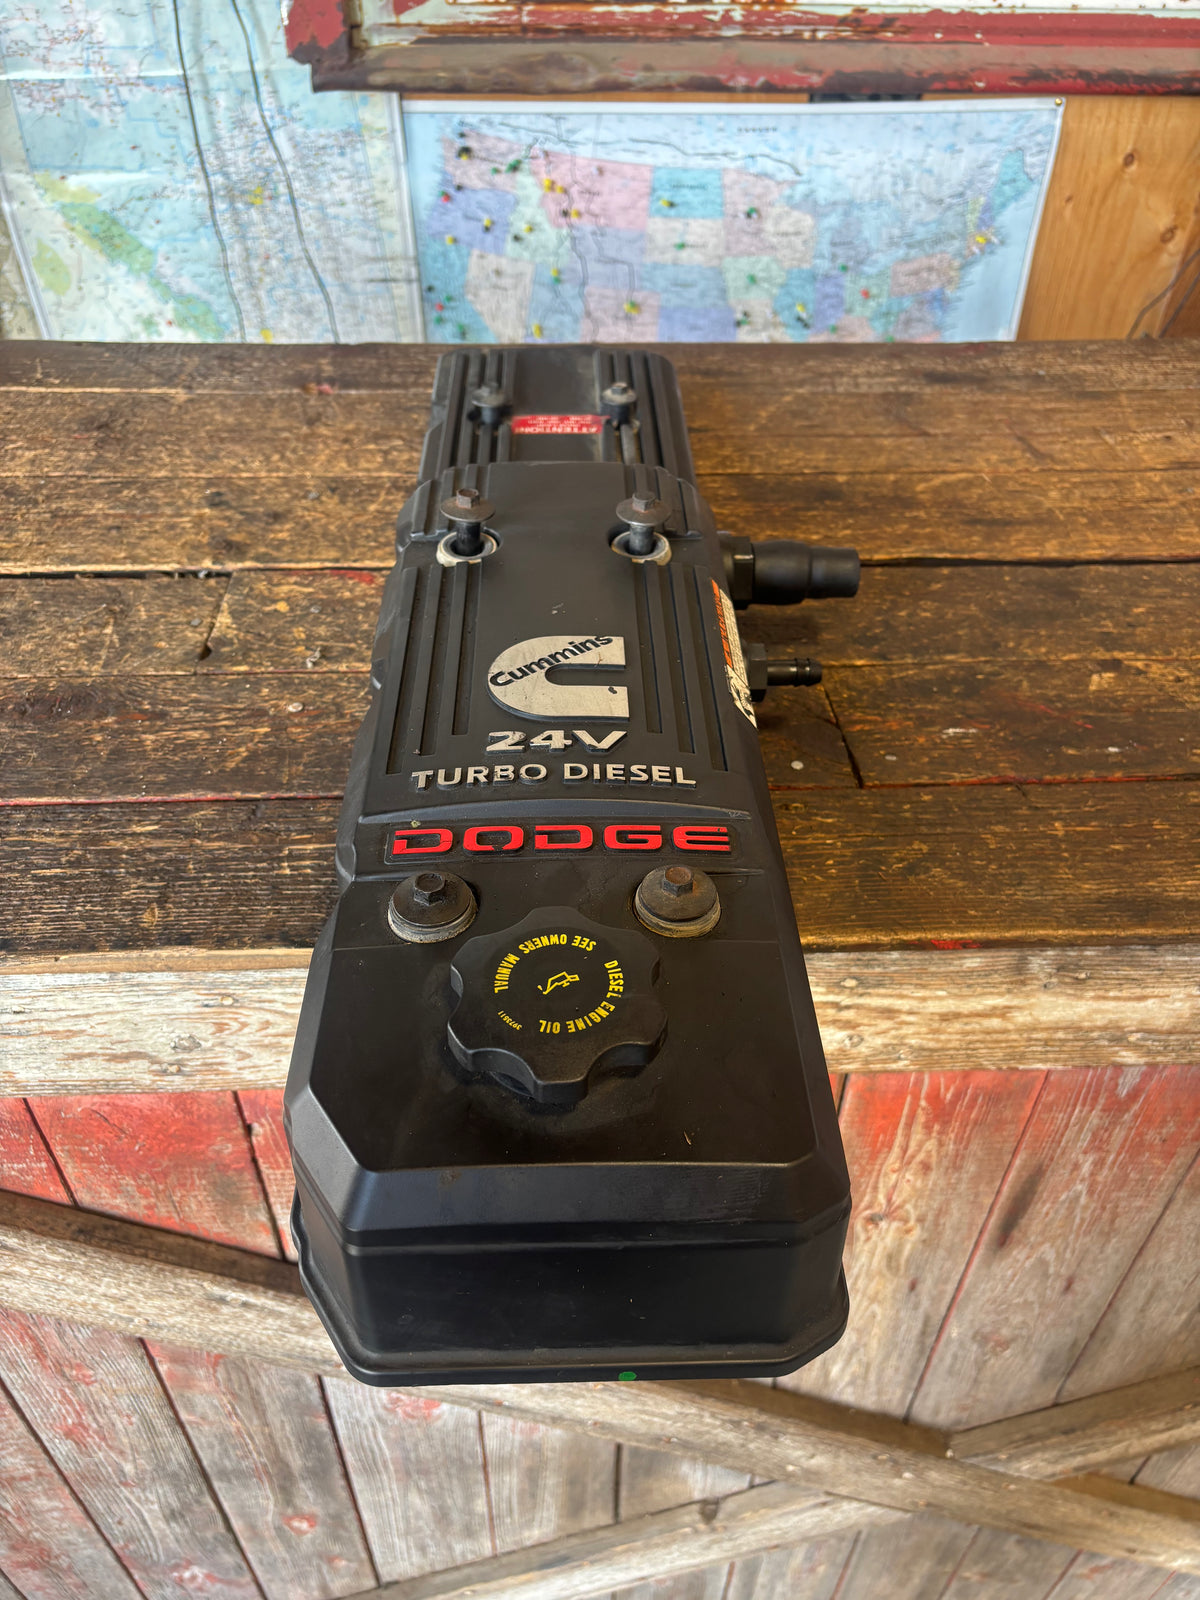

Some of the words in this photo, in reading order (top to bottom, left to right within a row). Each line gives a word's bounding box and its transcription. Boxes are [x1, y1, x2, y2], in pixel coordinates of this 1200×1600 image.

[489, 635, 614, 686] Cummins
[486, 729, 627, 752] 24V
[412, 763, 548, 791] TURBO
[563, 763, 697, 787] DIESEL
[392, 824, 732, 854] DODGE
[518, 933, 568, 954] OWNERS
[571, 935, 597, 952] SEE
[493, 952, 521, 994] MANUAL
[603, 959, 625, 998] DIESEL
[538, 1019, 561, 1035] OIL
[565, 1000, 616, 1034] ENGINE
